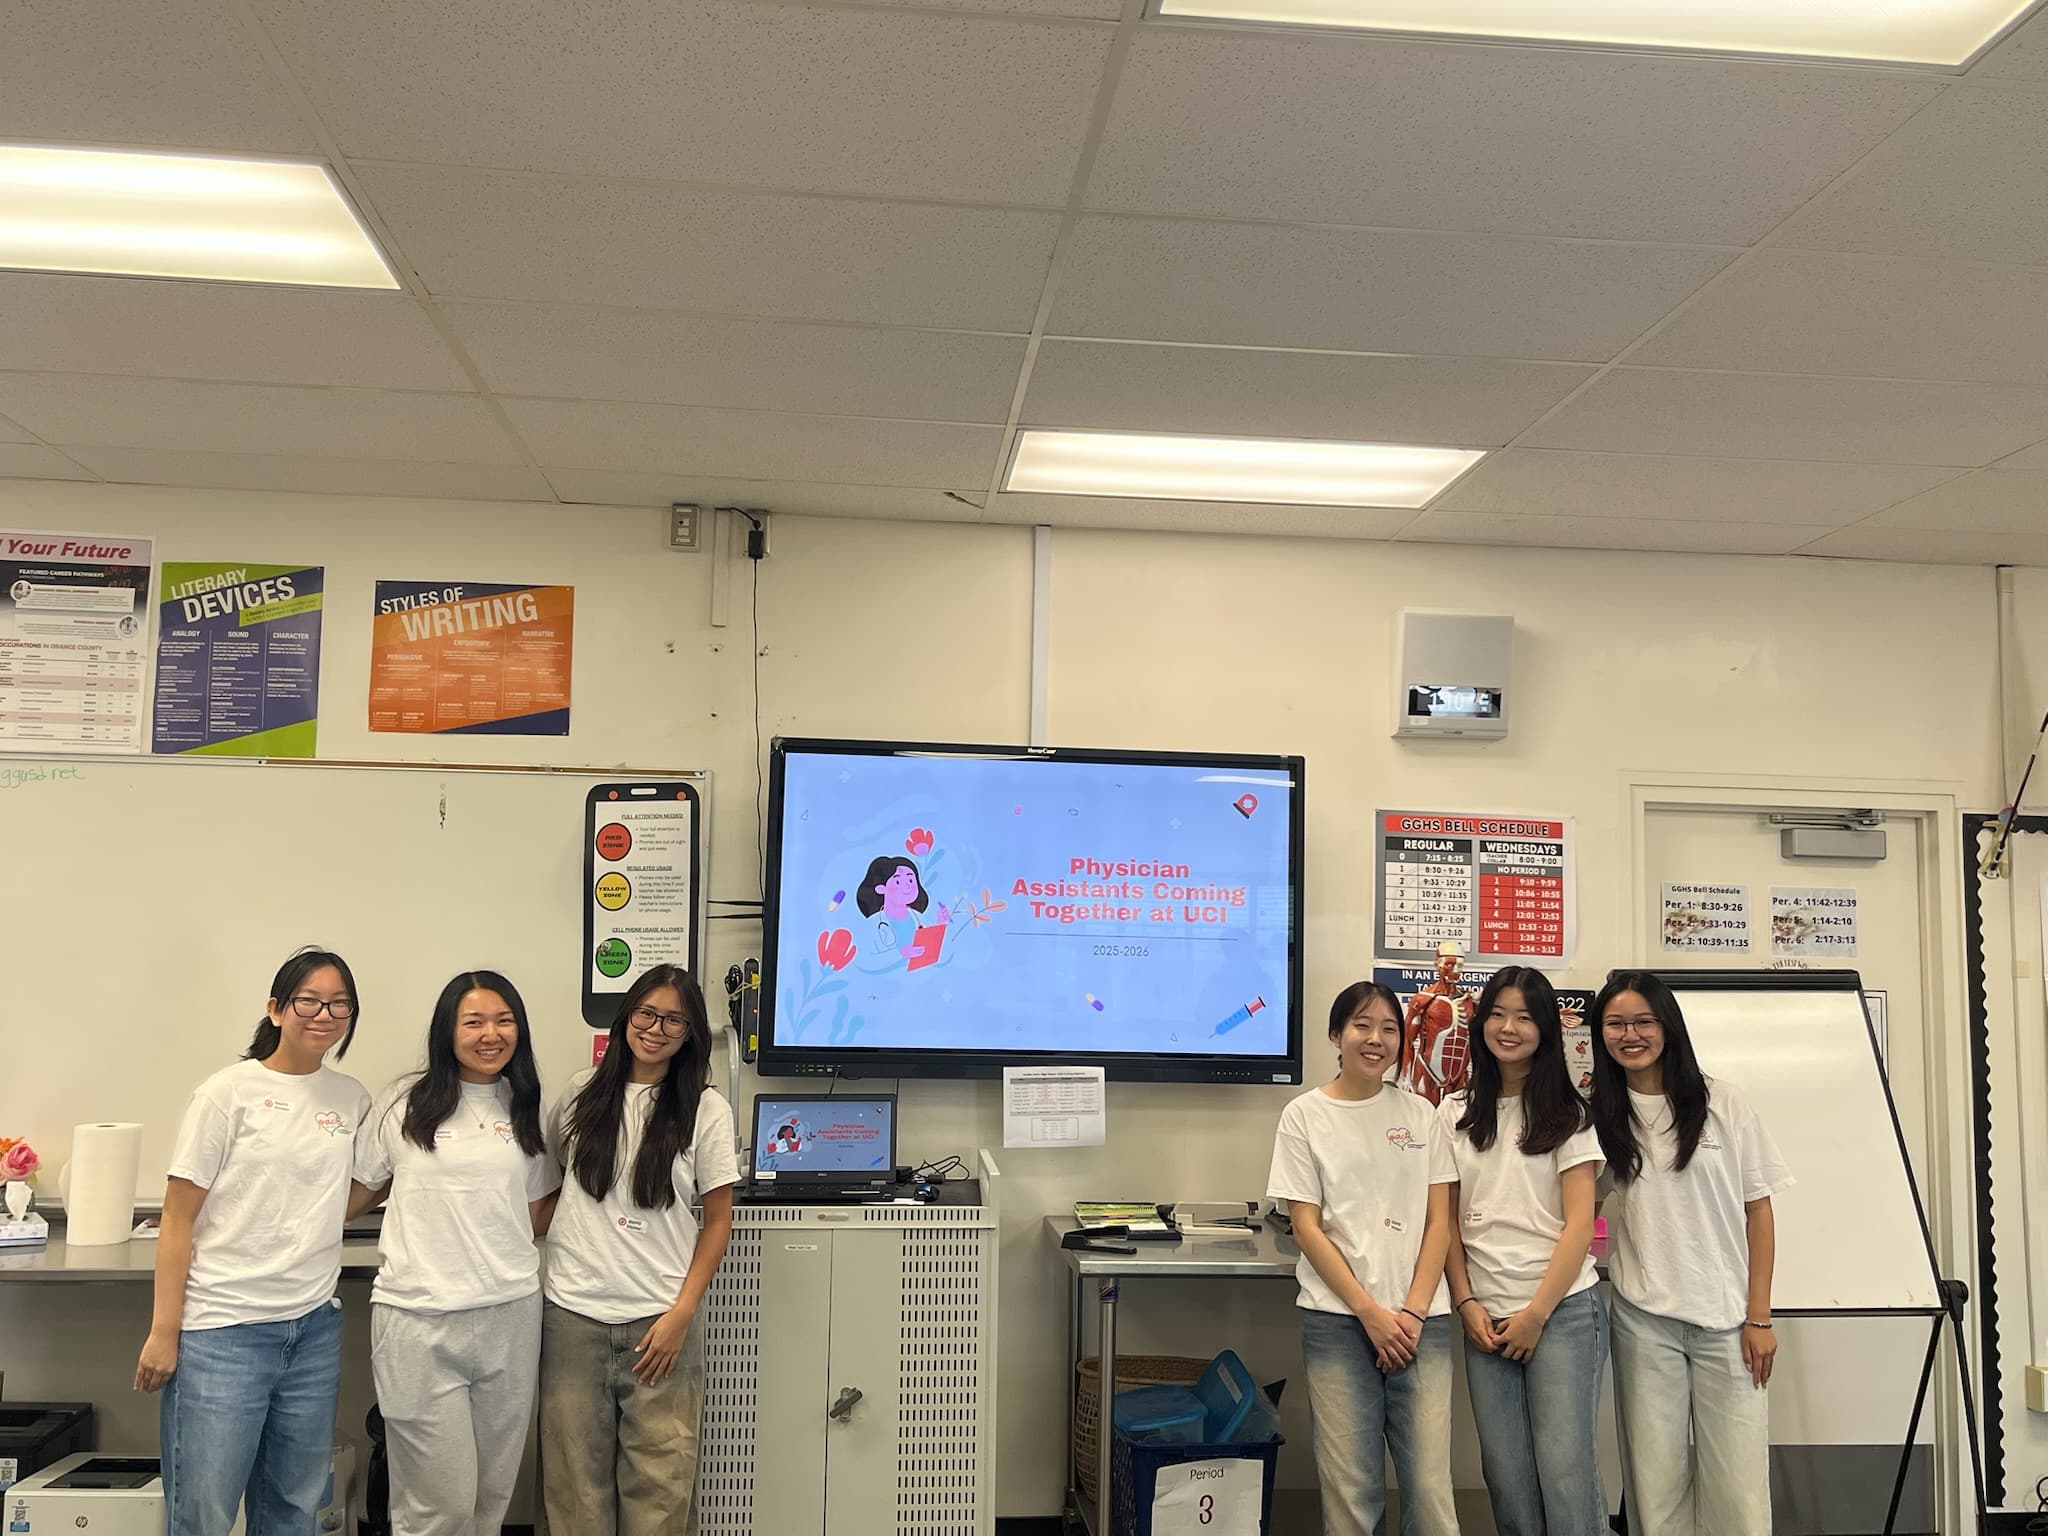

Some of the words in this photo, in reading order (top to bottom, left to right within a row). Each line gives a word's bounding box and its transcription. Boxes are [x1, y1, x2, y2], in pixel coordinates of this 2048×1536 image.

[7, 539, 57, 556] Your
[60, 542, 132, 559] Future
[171, 568, 247, 599] LITERARY
[183, 577, 295, 623] DEVICES
[380, 590, 439, 614] STYLES
[443, 586, 464, 603] OF
[401, 593, 538, 641] WRITING
[272, 632, 309, 640] CHARACTER
[522, 630, 554, 638] NARRATIVE
[1402, 819, 1440, 832] GGHS
[1445, 821, 1474, 833] BELL
[1480, 823, 1548, 836] SCHEDULE
[1404, 839, 1454, 851] REGULAR
[1486, 842, 1558, 855] WEDNESDAYS
[1400, 852, 1405, 860] 0
[1520, 856, 1535, 864] 8:00
[1070, 858, 1189, 880] Physician
[1494, 877, 1499, 885] 1
[1012, 879, 1144, 899] Assistants
[1153, 882, 1245, 907] Coming
[1494, 888, 1499, 896] 2
[1709, 887, 1740, 895] Schedule
[1494, 899, 1499, 907] 3
[1666, 900, 1685, 909] Per.
[1687, 901, 1695, 909] 1:
[1702, 902, 1743, 911] 8:30-9:26
[1772, 897, 1791, 905] Per.
[1794, 898, 1802, 906] 4:
[1806, 898, 1857, 907] 11:42-12:39
[1030, 901, 1142, 924] Together
[1150, 905, 1174, 922] at
[1183, 906, 1227, 923] UCI
[1494, 910, 1499, 918] 4
[1666, 918, 1685, 927] Per.
[1700, 920, 1746, 928] 9:33-10:29
[1773, 916, 1792, 924] Per.
[1812, 917, 1852, 925] 1:14-2:10
[1494, 932, 1499, 940] 5
[1666, 936, 1684, 945] Per.
[1698, 938, 1749, 947] 10:39-11:35
[1775, 936, 1794, 944] Per.
[1796, 936, 1804, 944] 6:
[1815, 936, 1856, 944] 2:17-3:13
[1093, 945, 1150, 957] 2025-2026
[1402, 970, 1414, 980] IN
[1415, 970, 1431, 980] AN
[1190, 1467, 1224, 1480] Period
[1200, 1494, 1214, 1524] 3
